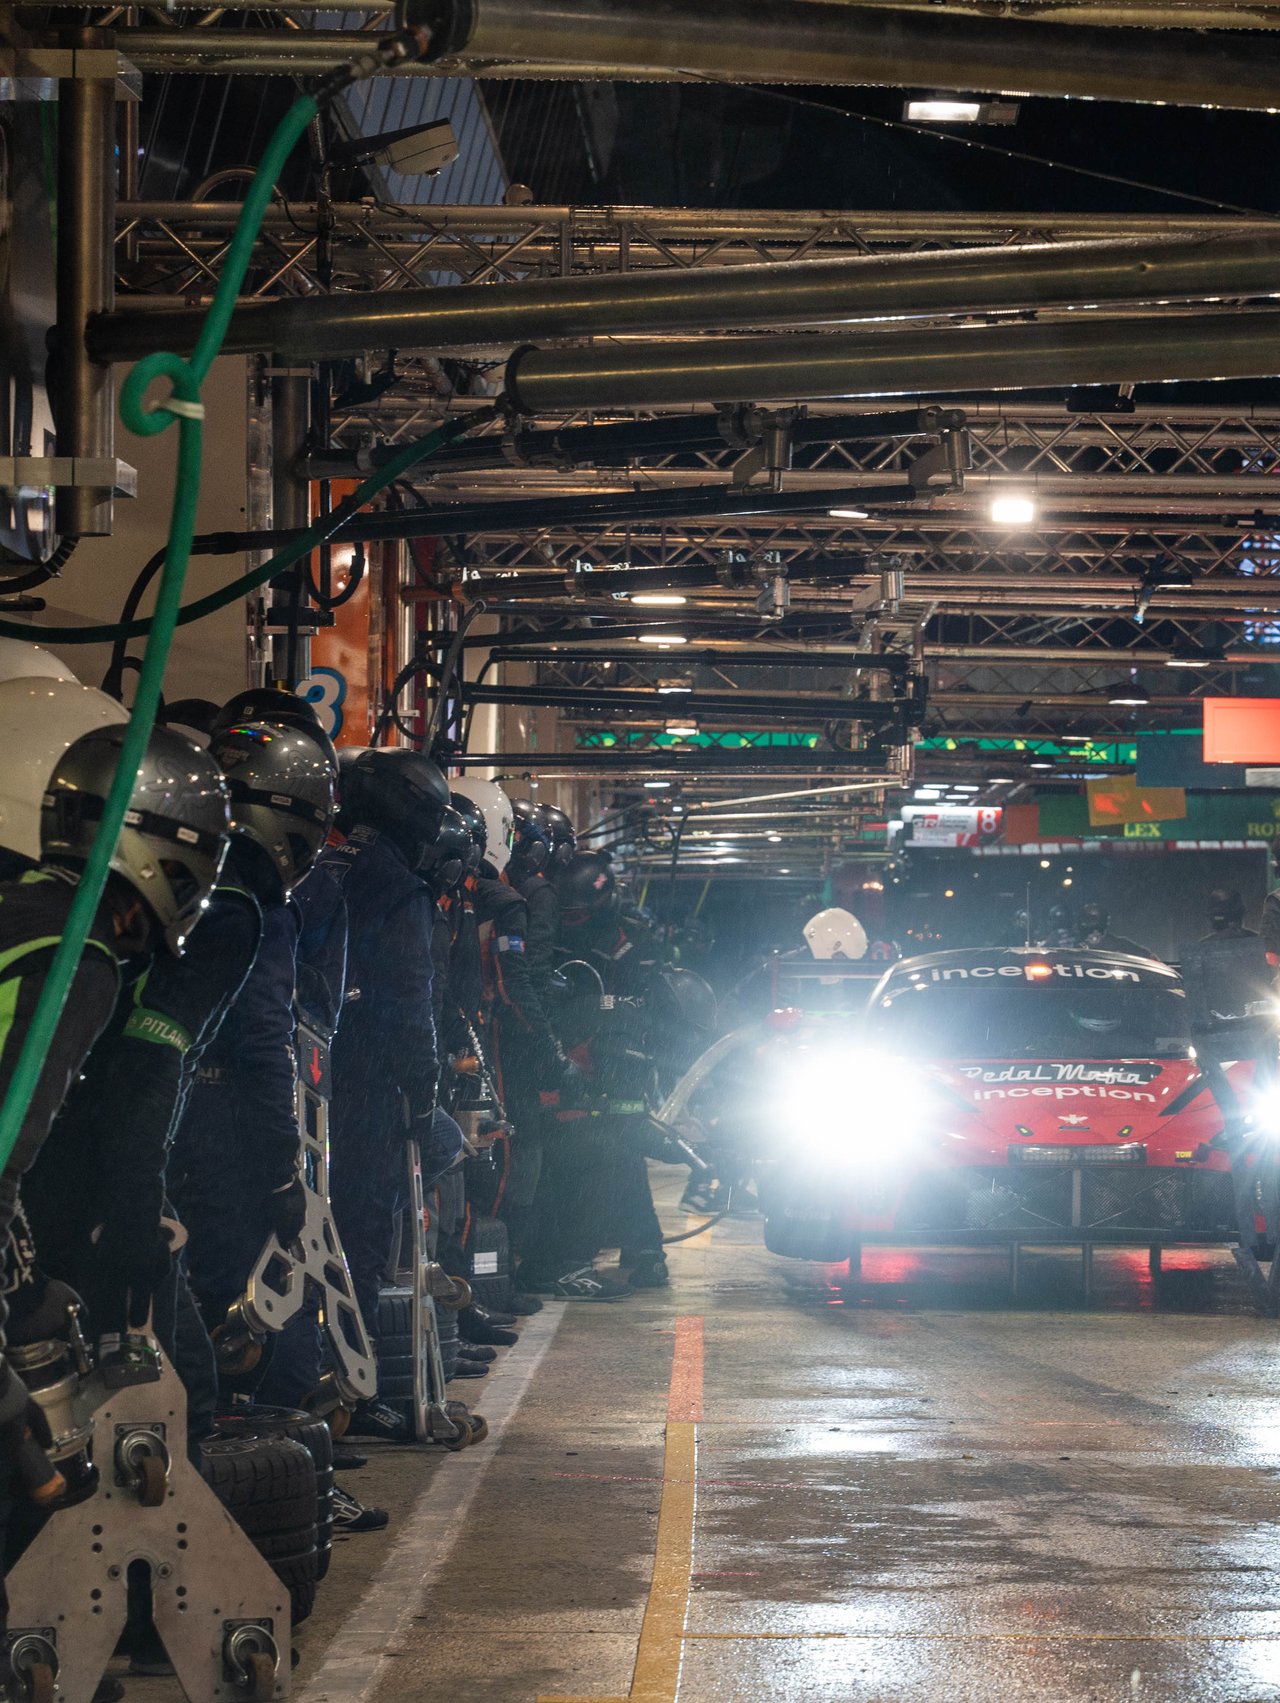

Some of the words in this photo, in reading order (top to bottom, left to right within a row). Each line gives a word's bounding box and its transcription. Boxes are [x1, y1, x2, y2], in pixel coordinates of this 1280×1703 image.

[1123, 822, 1162, 838] LEX
[931, 963, 1141, 983] inception
[959, 1065, 1048, 1083] Pedal
[973, 1085, 1157, 1103] inception
[1175, 1150, 1193, 1159] TOW
